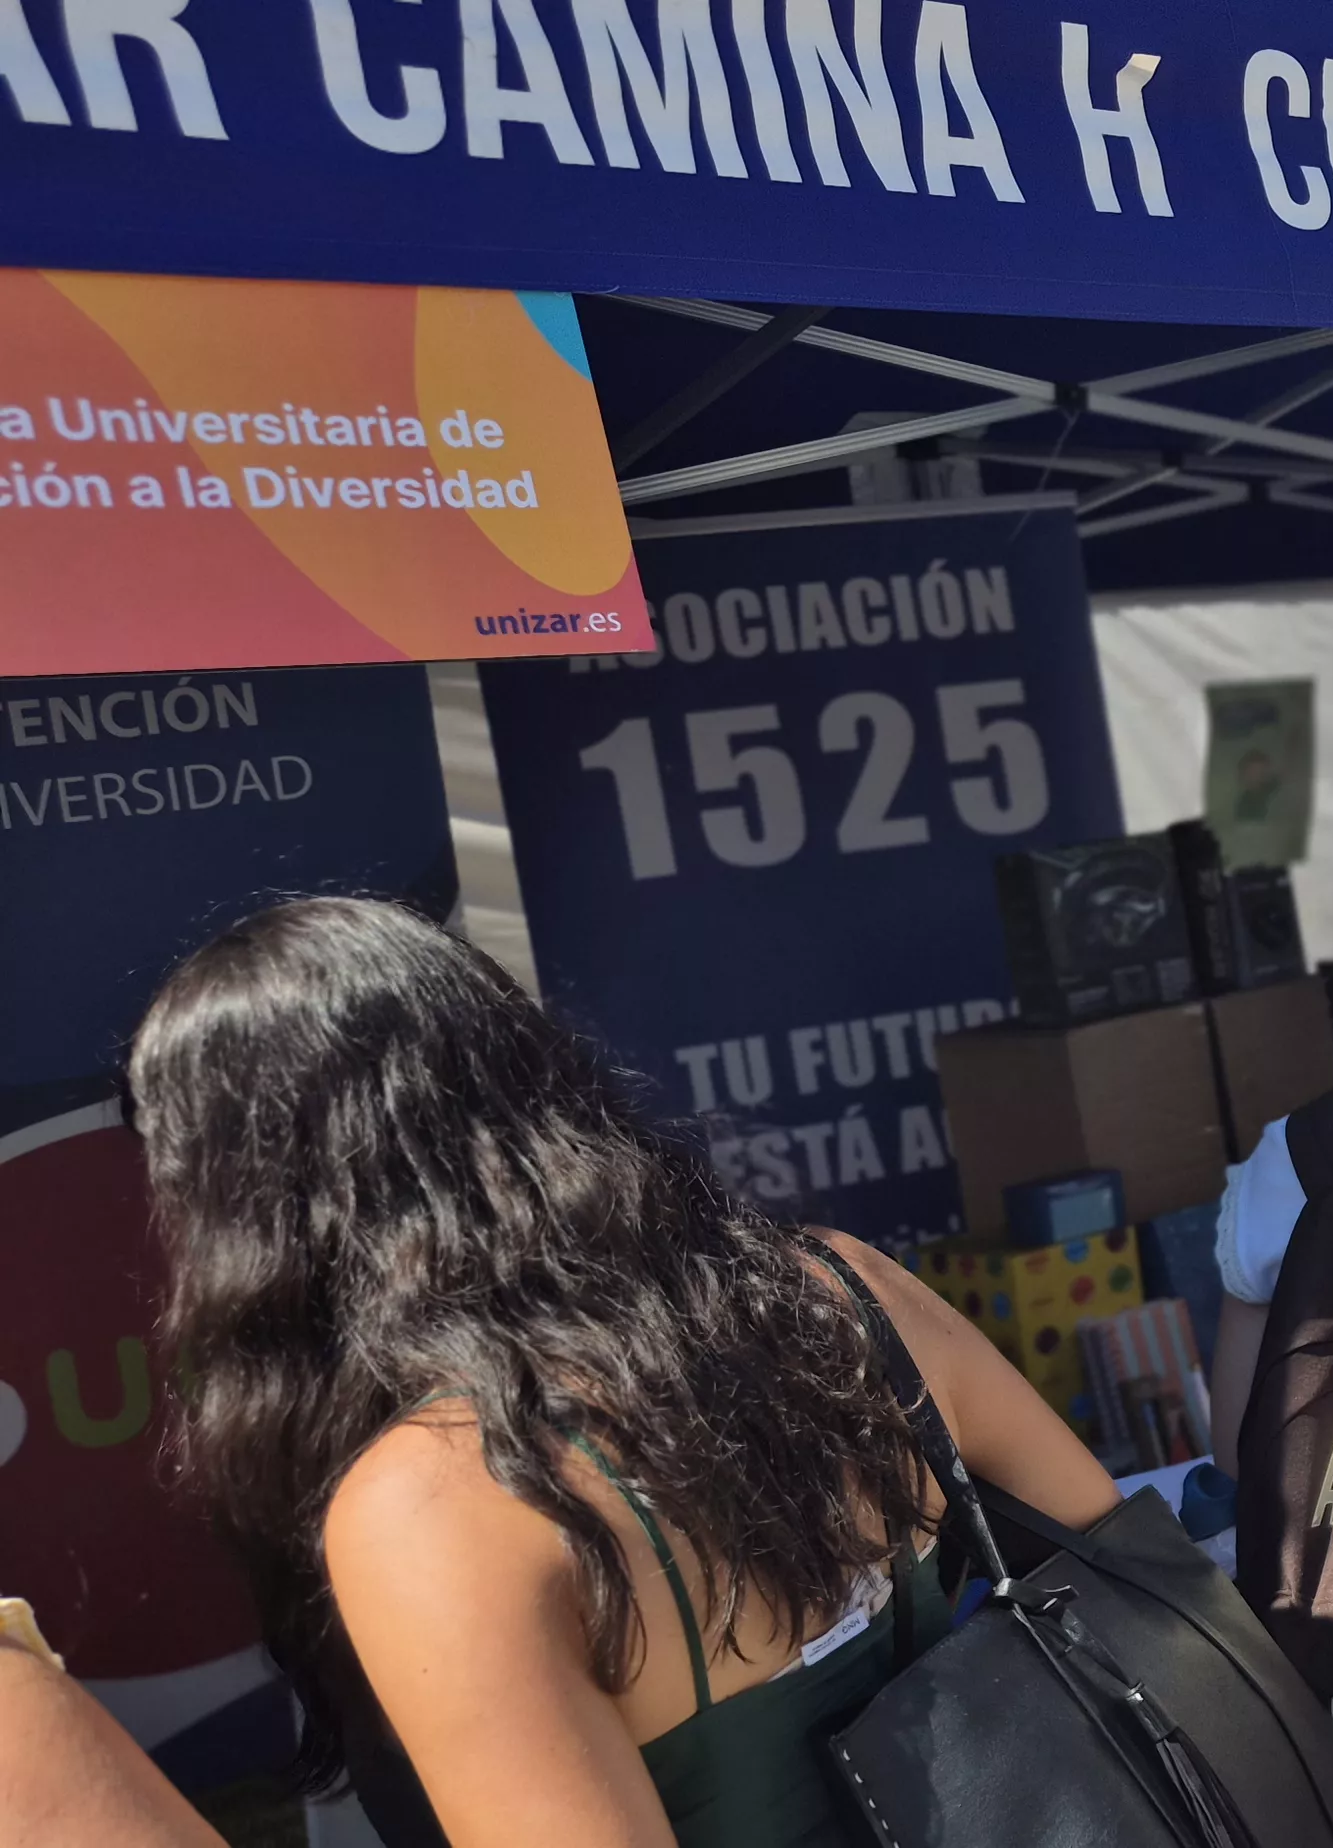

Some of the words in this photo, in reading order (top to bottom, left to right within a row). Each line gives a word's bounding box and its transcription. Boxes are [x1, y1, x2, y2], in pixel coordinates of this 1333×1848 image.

[315, 0, 1025, 205] CAMINA
[47, 397, 428, 448] Universitaria
[439, 409, 505, 451] de
[130, 477, 165, 509] a
[179, 465, 232, 509] la
[243, 465, 539, 511] Diversidad
[474, 607, 623, 638] unizar.es
[569, 559, 1015, 674] OCIACIÓN
[0, 678, 259, 748] ENCIÓN
[578, 679, 1051, 881] 1525
[673, 1034, 774, 1113] TU
[788, 996, 1021, 1096] FUTU
[708, 1103, 887, 1199] ESTÁ
[899, 1104, 957, 1175] A
